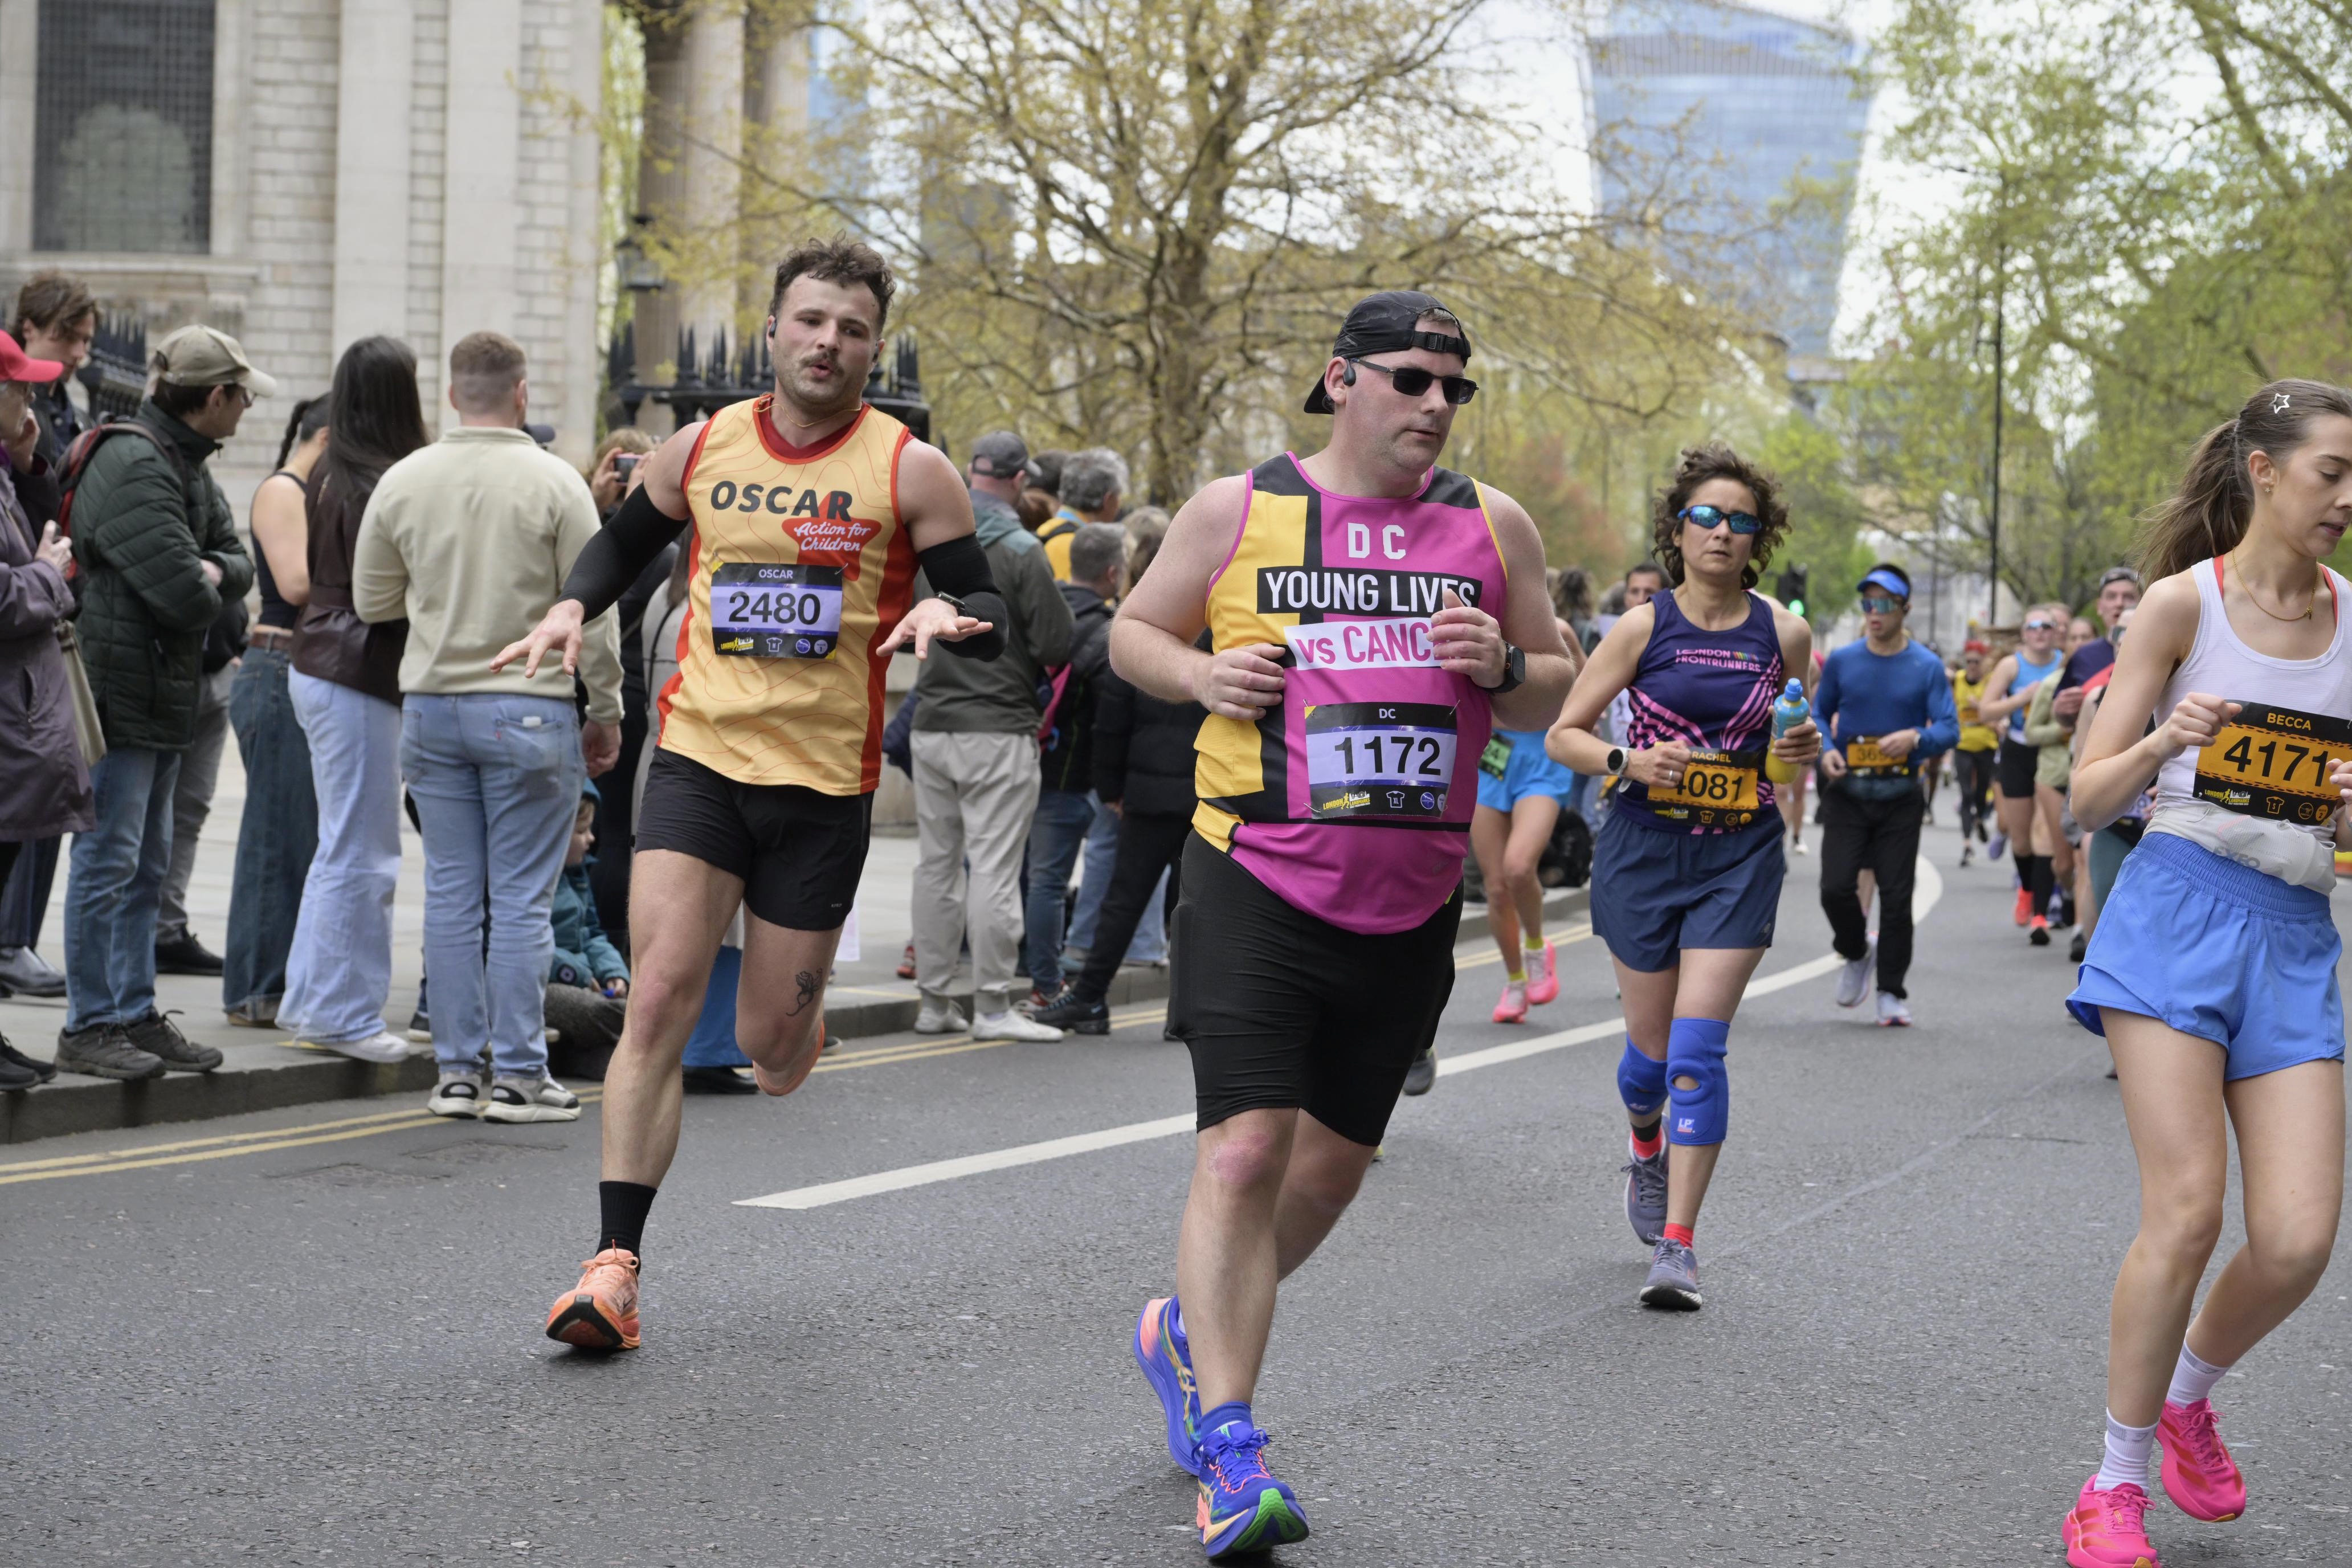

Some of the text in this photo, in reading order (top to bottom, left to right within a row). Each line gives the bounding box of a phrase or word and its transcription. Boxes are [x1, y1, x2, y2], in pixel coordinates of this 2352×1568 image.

[710, 480, 853, 522] OSCAR
[793, 522, 871, 538] Action for
[801, 537, 861, 552] Children
[758, 569, 794, 579] OSCAR
[1265, 571, 1379, 611] YOUNG
[728, 591, 821, 626] 2480
[1343, 622, 1448, 663] CANC
[1676, 648, 1731, 658] LONDON
[1379, 708, 1396, 719] DC
[2267, 713, 2312, 731] BECCA
[1334, 736, 1442, 777] 1172
[1692, 751, 1732, 762] RACHEL
[2223, 736, 2329, 787] 4171
[2204, 789, 2224, 798] LONDON
[1323, 798, 1344, 810] LONDON
